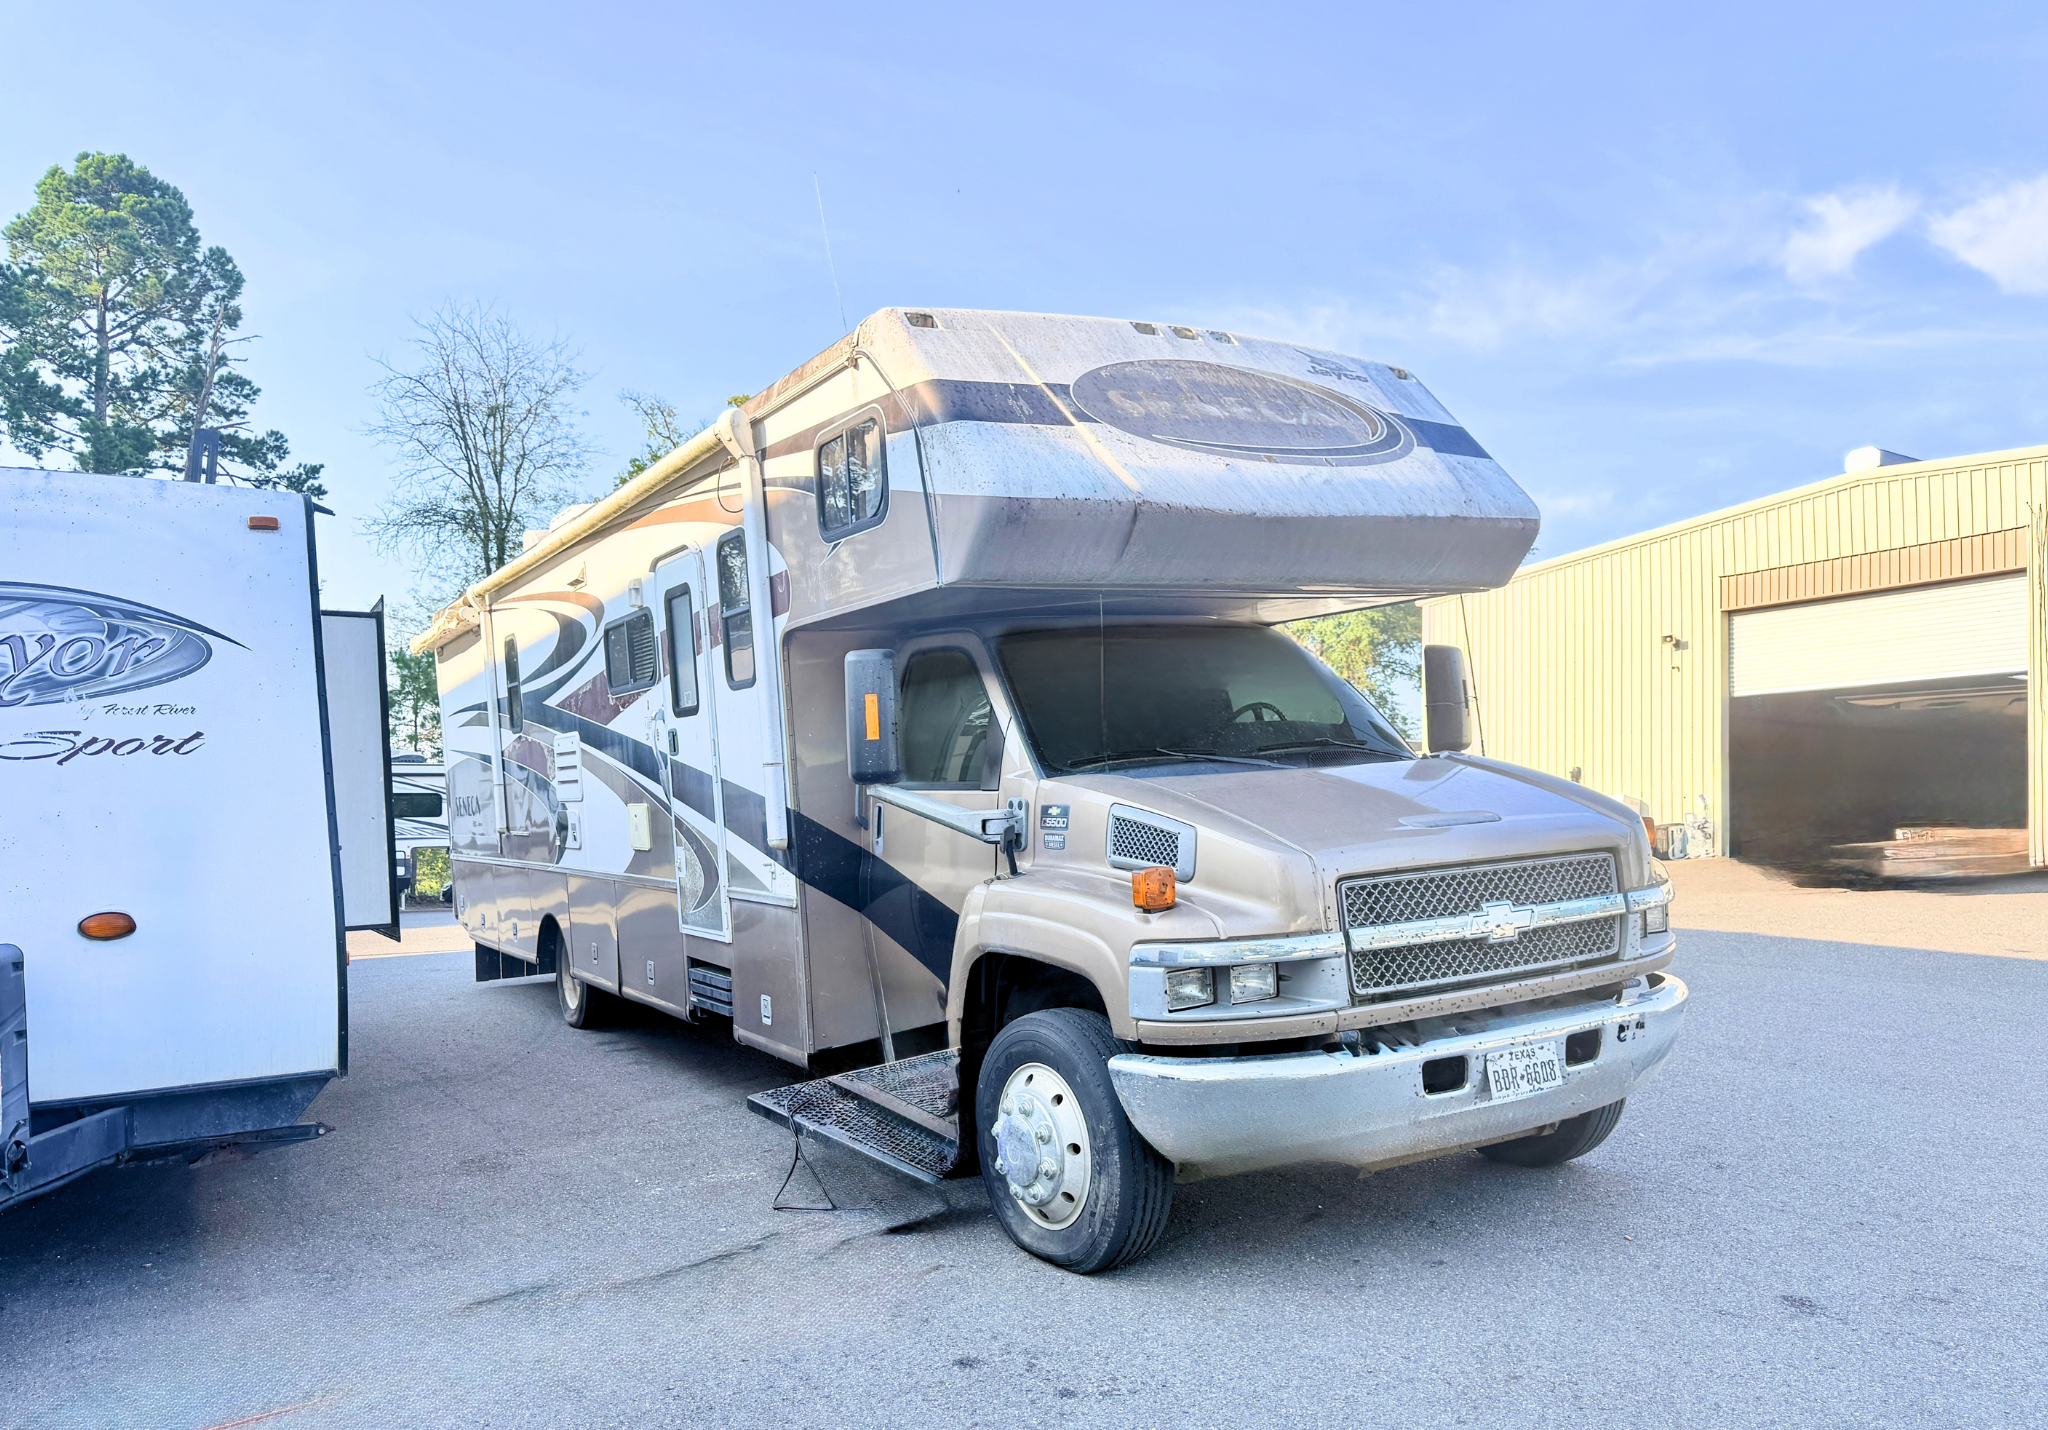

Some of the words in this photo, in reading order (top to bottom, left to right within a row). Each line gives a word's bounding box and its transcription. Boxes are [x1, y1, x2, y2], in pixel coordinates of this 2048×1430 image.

[153, 703, 198, 716] River
[0, 730, 206, 766] Sport
[455, 795, 481, 817] SENECA
[1041, 817, 1068, 828] C5500
[1508, 1047, 1536, 1061] TEXAS
